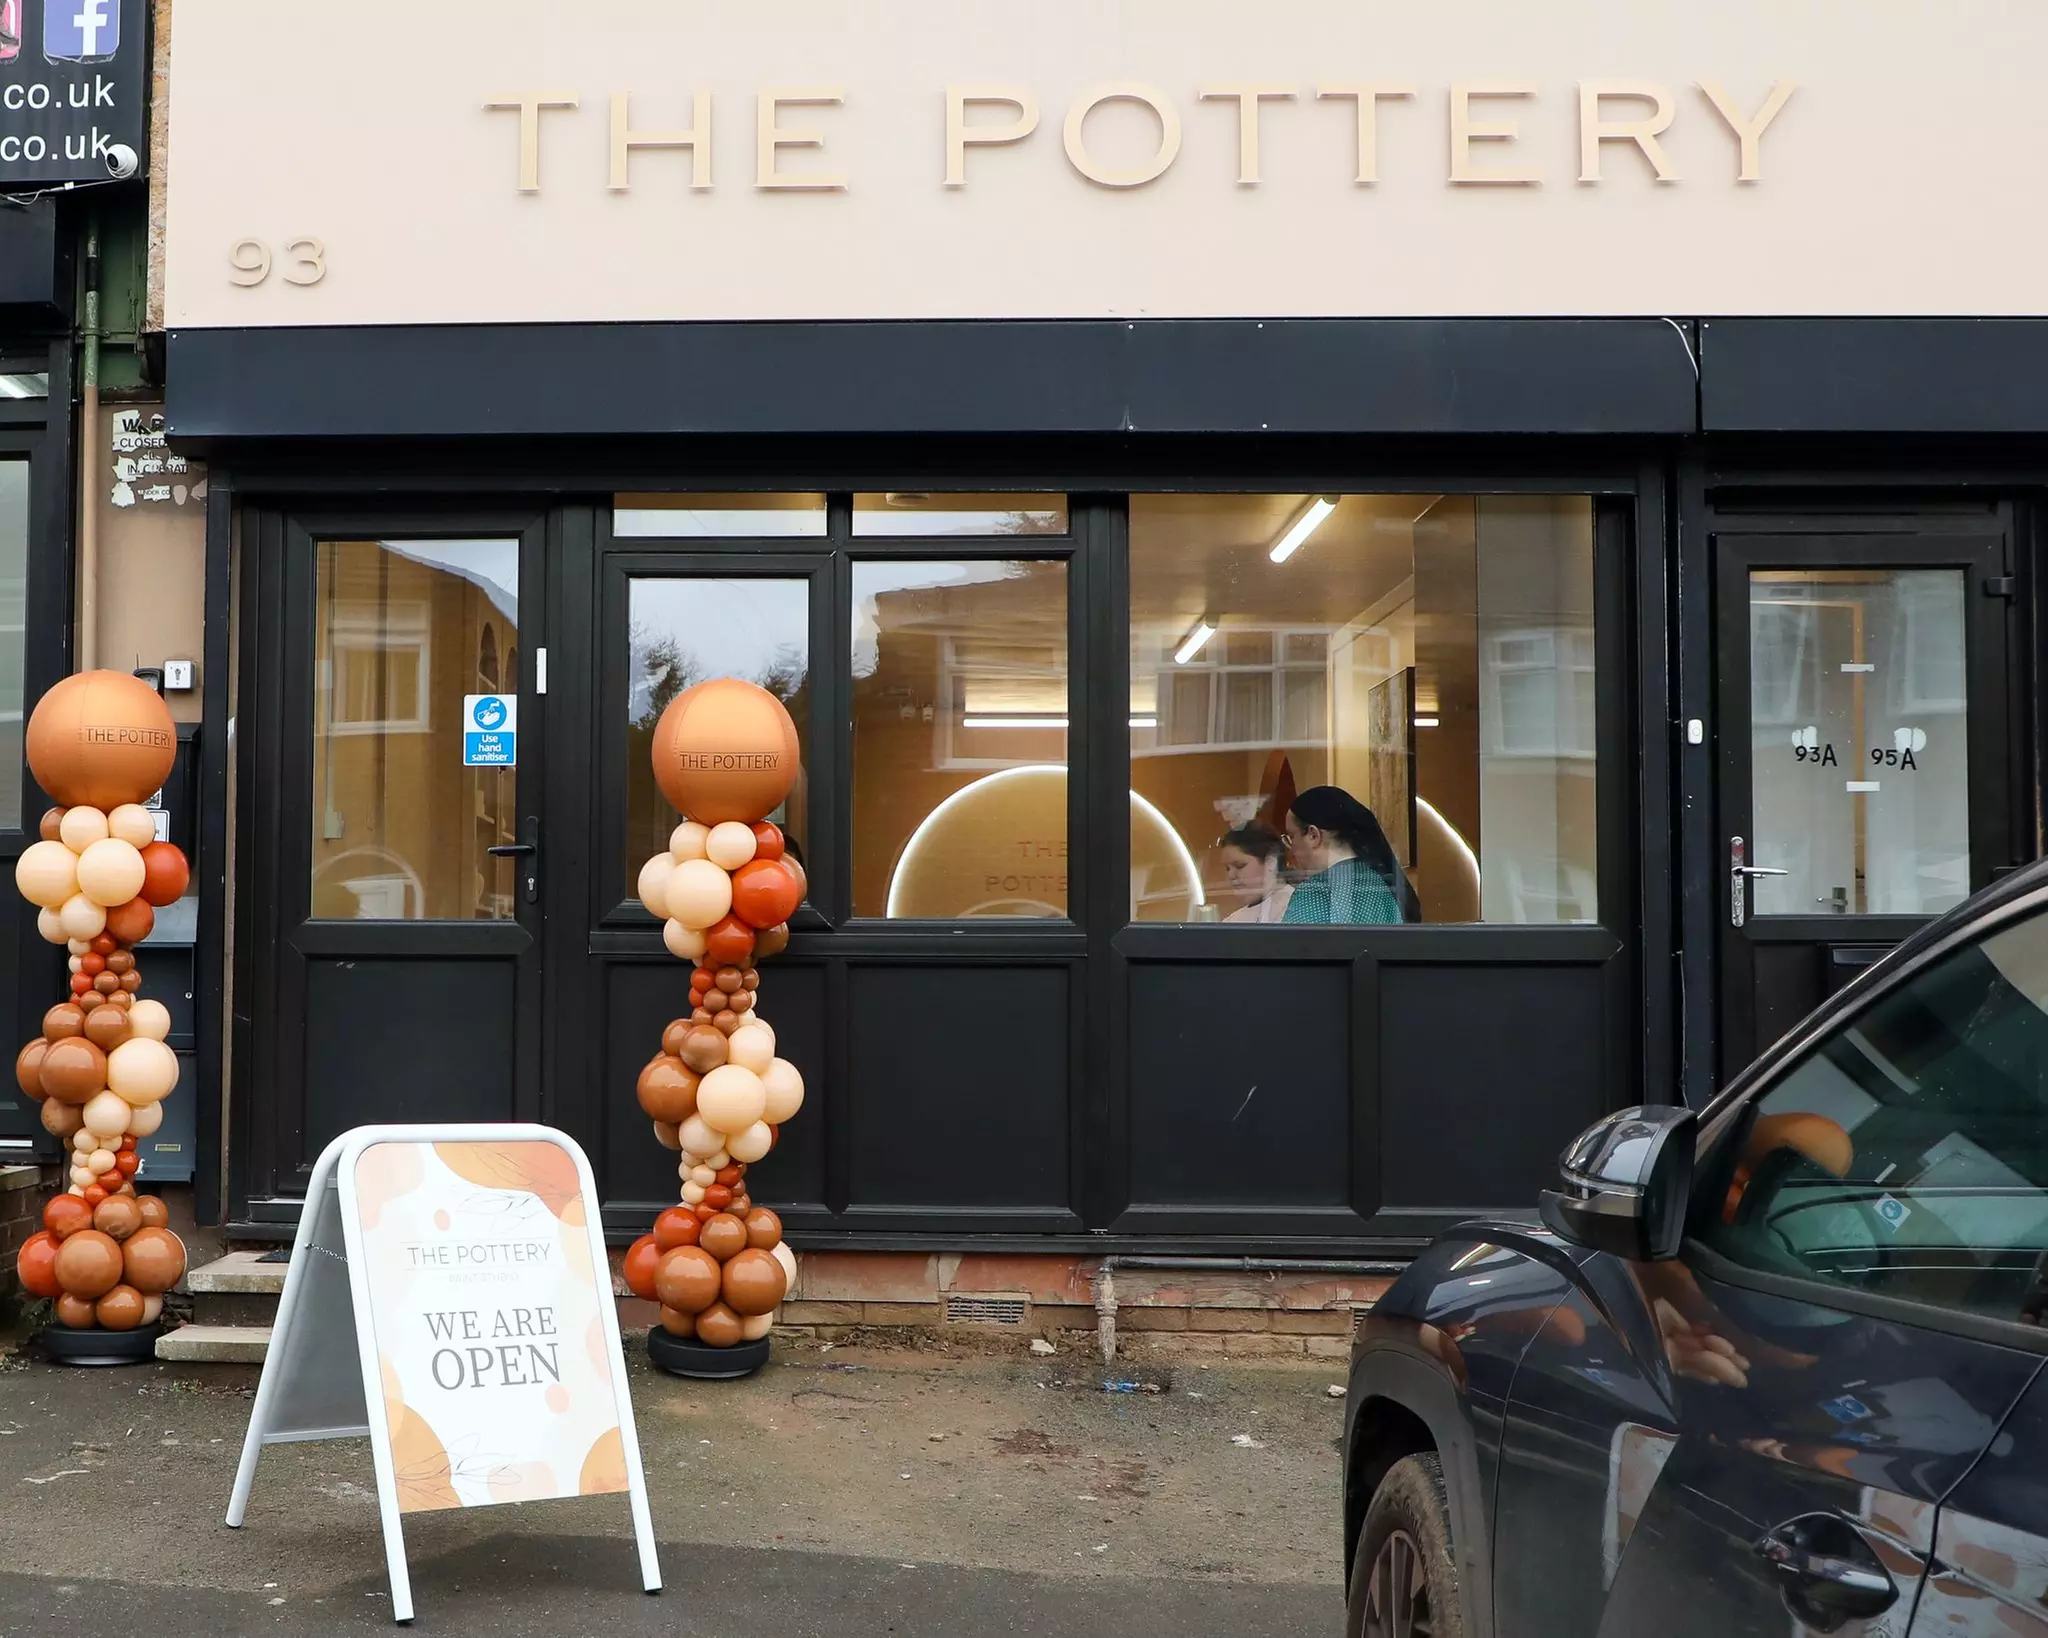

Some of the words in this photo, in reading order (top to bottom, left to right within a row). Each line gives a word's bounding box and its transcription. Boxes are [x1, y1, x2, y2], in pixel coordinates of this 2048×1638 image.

[481, 88, 848, 192] THE
[943, 79, 1800, 190] POTTERY
[227, 237, 326, 287] 93
[85, 728, 115, 743] THE
[119, 729, 171, 747] POTTERY
[478, 744, 502, 752] hand
[481, 734, 498, 743] Use
[471, 753, 508, 762] sanitiser
[680, 754, 708, 769] THE
[713, 754, 779, 770] POTTERY
[1795, 744, 1837, 767] 93A
[1871, 748, 1917, 771] 95A
[1019, 841, 1068, 858] THE
[985, 875, 1068, 892] POTTE
[407, 1246, 451, 1266] THE
[456, 1242, 551, 1264] POTTERY
[423, 1310, 481, 1341] WE
[491, 1307, 557, 1338] ARE
[432, 1343, 560, 1390] OPEN
